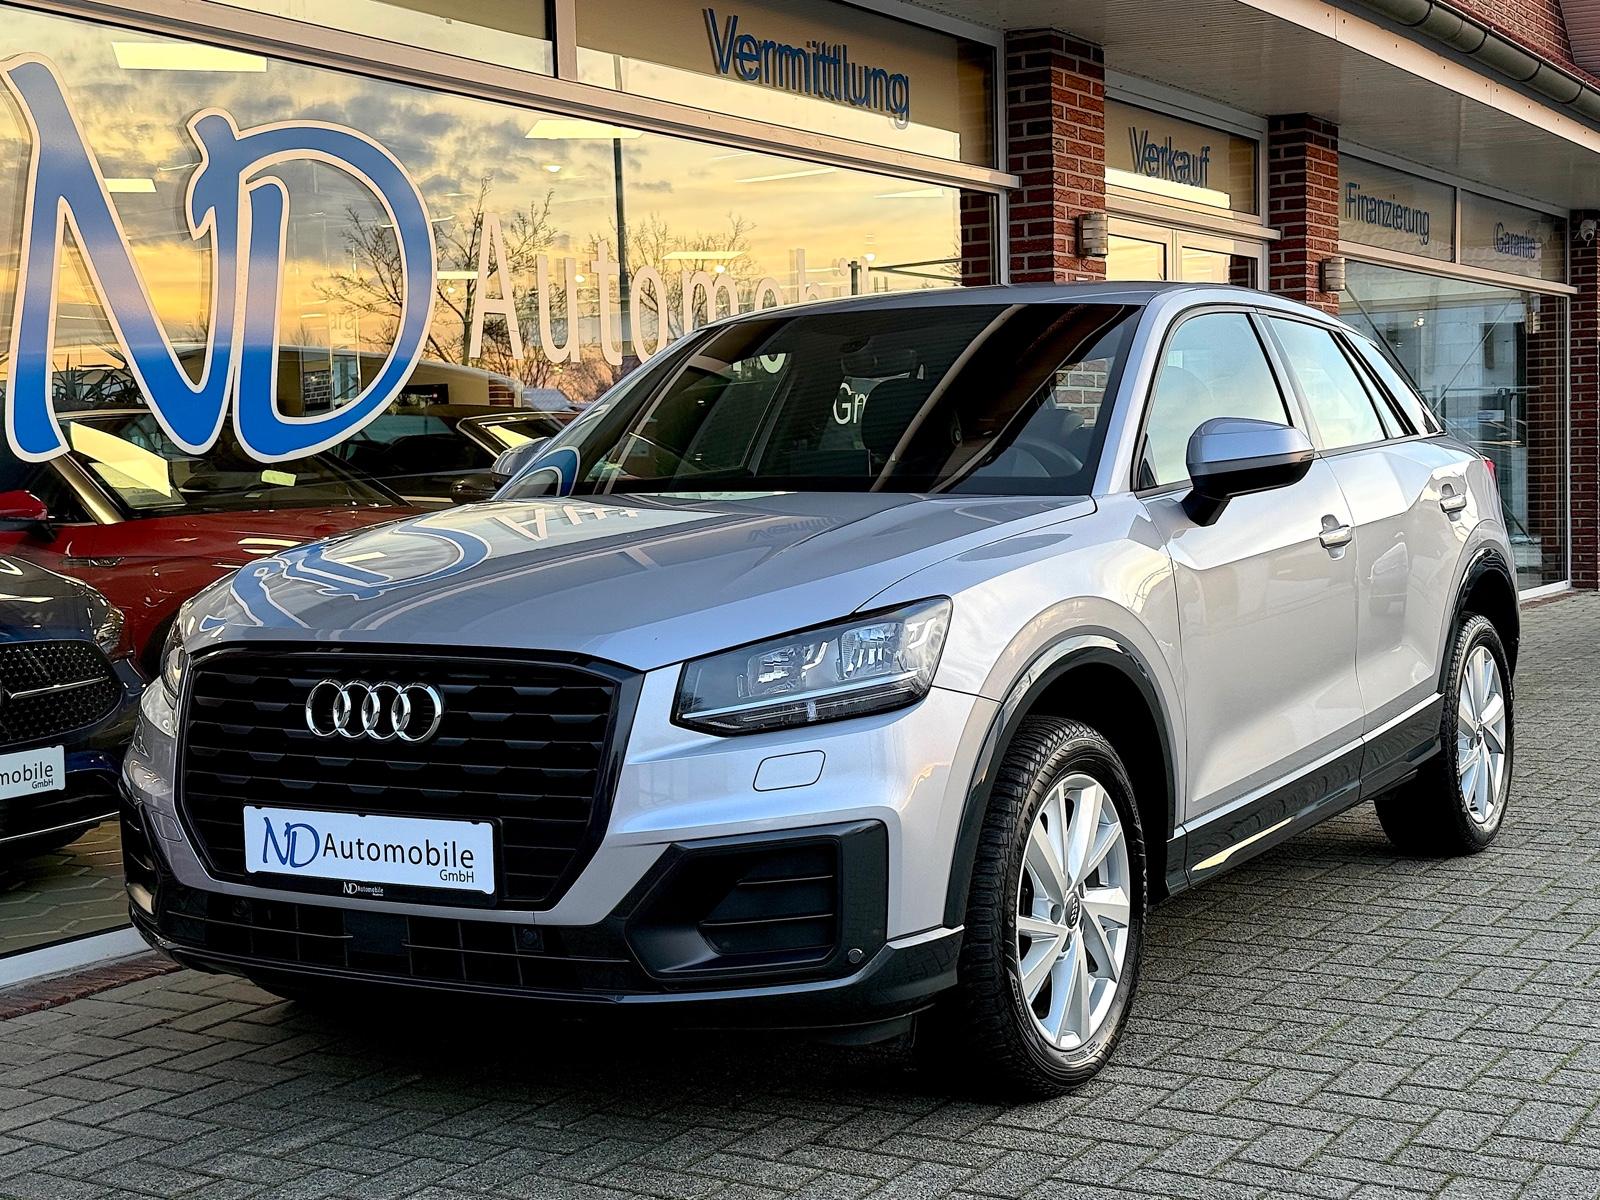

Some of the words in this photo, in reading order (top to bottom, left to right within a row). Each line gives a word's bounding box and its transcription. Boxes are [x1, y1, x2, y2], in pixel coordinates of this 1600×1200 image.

[703, 8, 910, 128] Vermittlung
[1128, 126, 1210, 188] Verkauf
[1345, 182, 1430, 246] Finanzierung
[0, 52, 437, 463] ND
[1494, 222, 1536, 259] Garantie
[32, 778, 54, 789] GmbH
[262, 816, 320, 868] ND
[323, 833, 474, 868] Automobile
[343, 881, 357, 894] ND
[439, 869, 475, 883] GmbH
